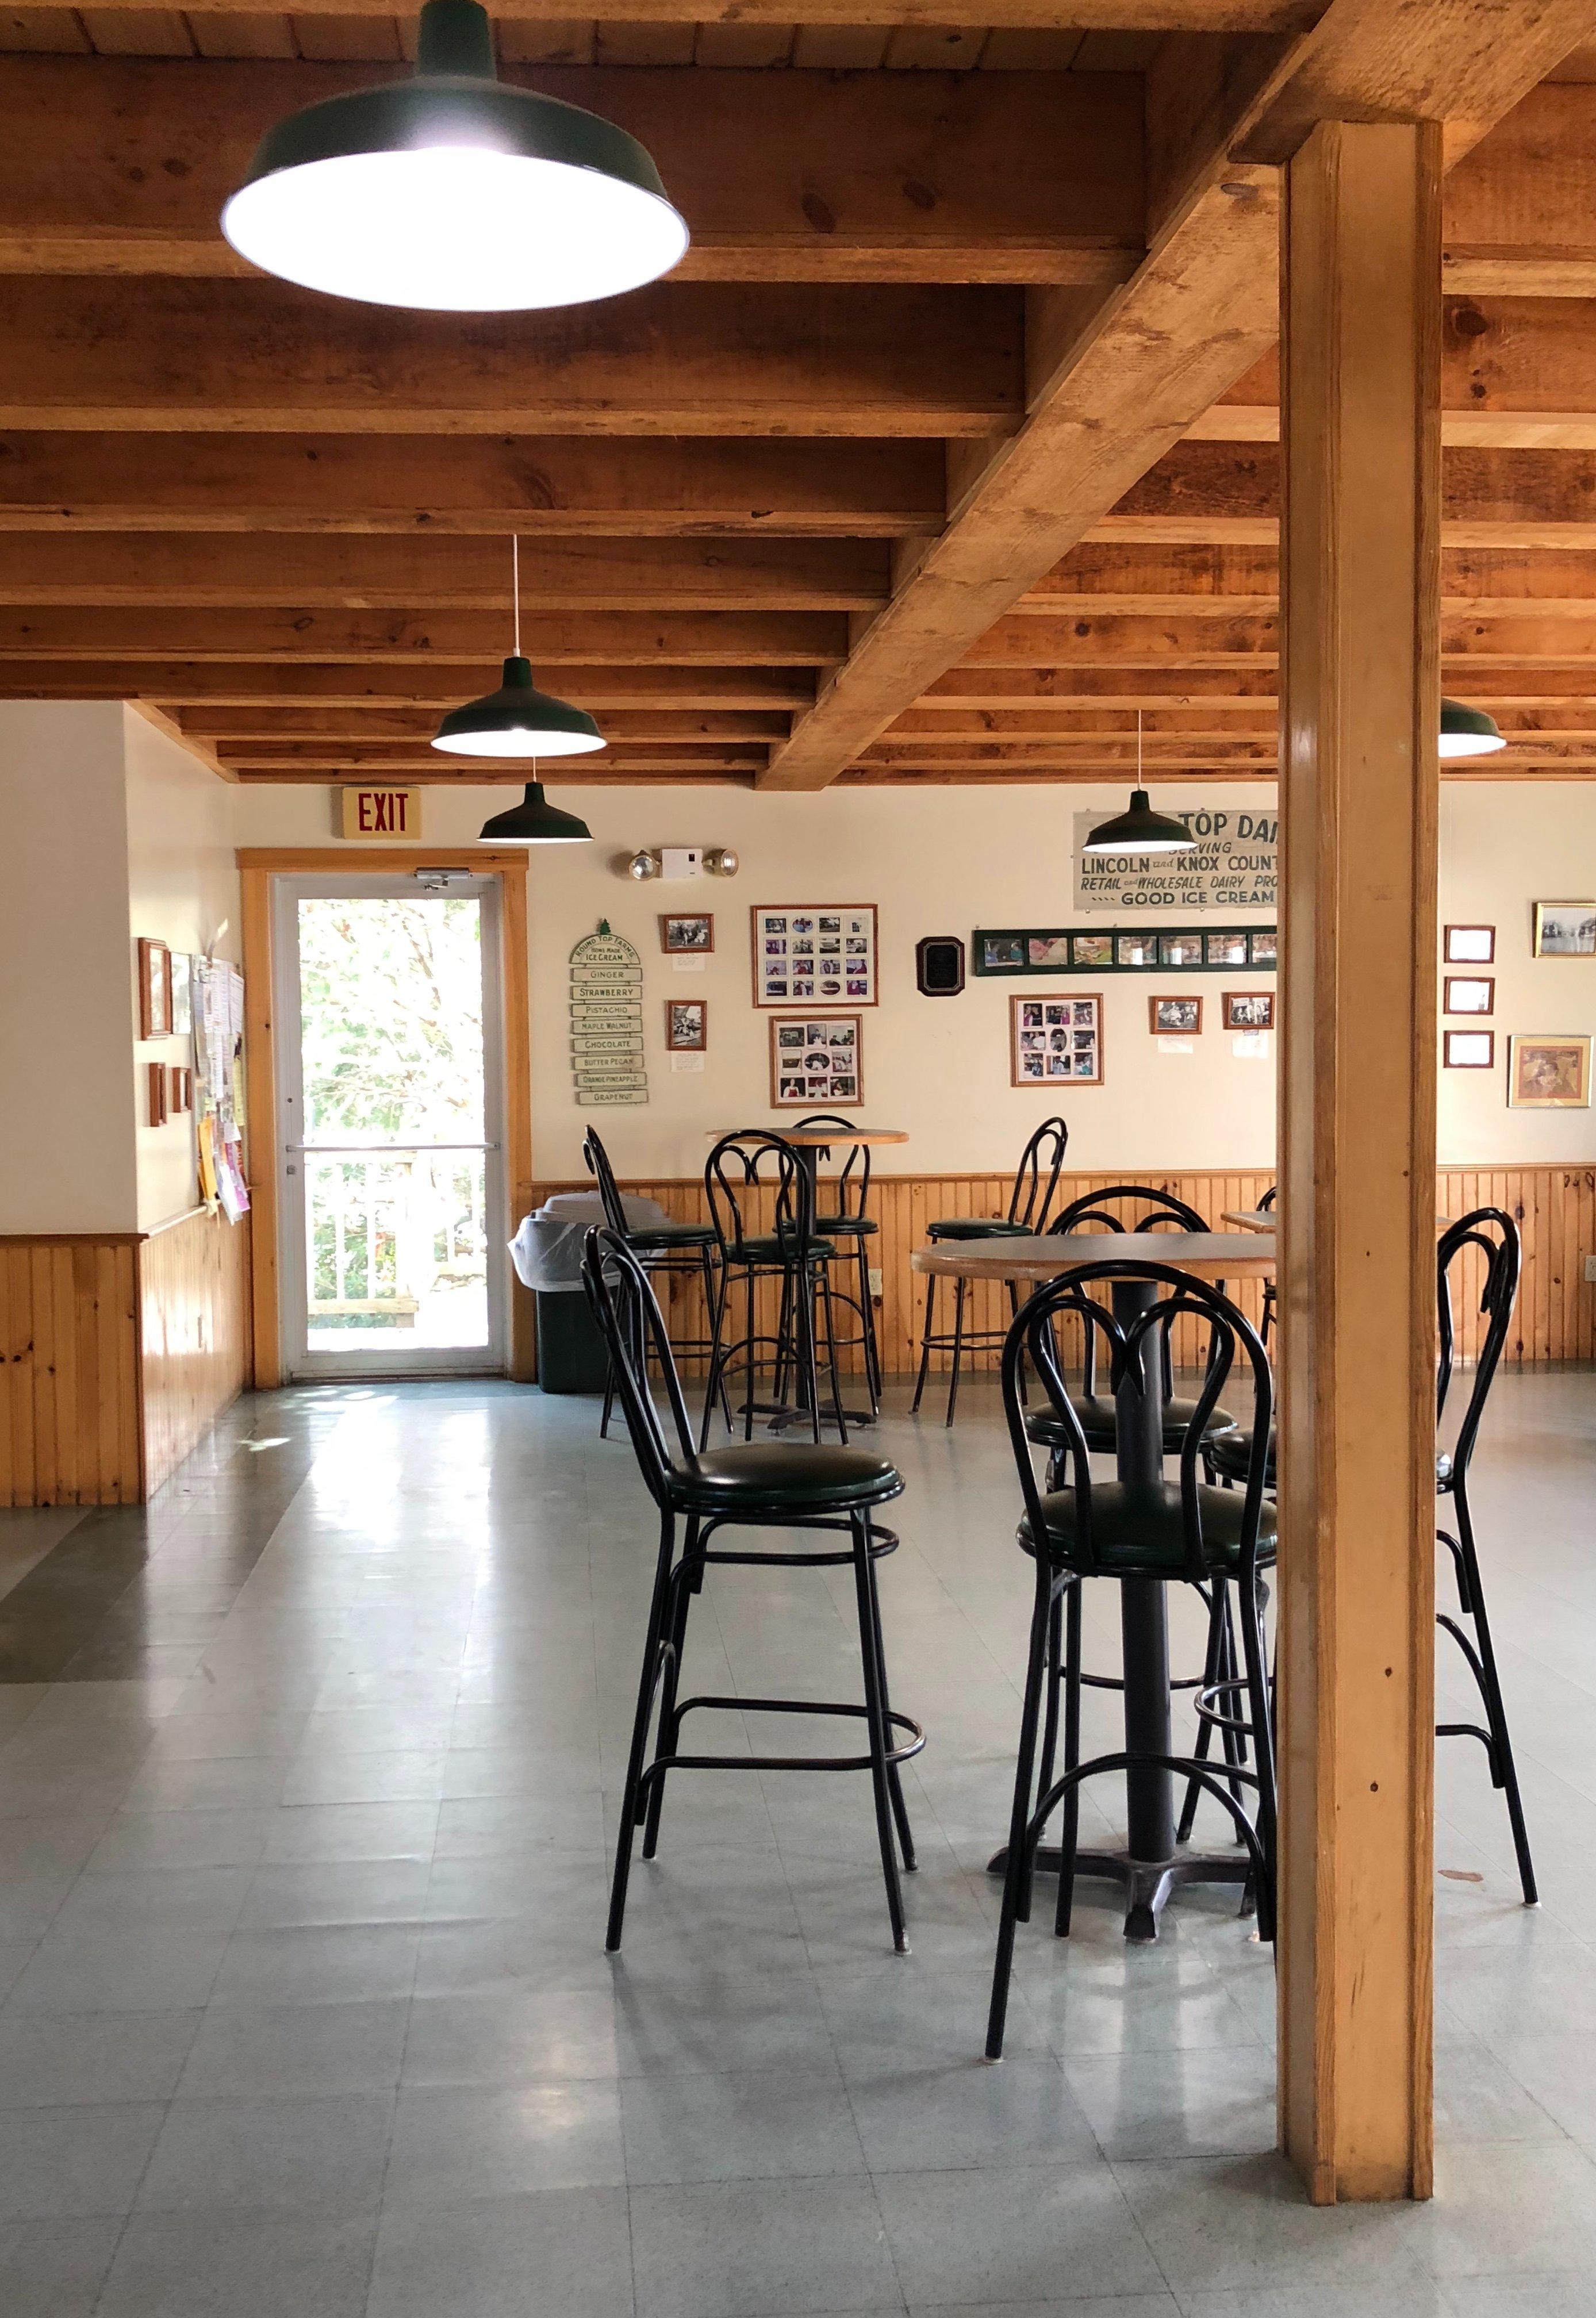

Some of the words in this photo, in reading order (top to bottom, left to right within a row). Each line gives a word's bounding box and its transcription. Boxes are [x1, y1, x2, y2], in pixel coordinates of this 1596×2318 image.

[358, 793, 409, 832] EXIT
[1178, 813, 1227, 836] TOP
[1237, 815, 1279, 843] DAI
[1081, 857, 1150, 874] LINCOLN
[1153, 858, 1174, 868] and
[1177, 856, 1219, 872] KNOX
[1081, 877, 1122, 891] RETAIL
[1137, 876, 1203, 889] WHOLESALE
[1210, 876, 1246, 888] DAIRY
[1121, 892, 1175, 905] GOOD
[1181, 891, 1207, 904] ICE
[1215, 891, 1275, 904] CREAM
[576, 938, 596, 957] ROUND
[614, 938, 635, 957] FARMS
[598, 953, 623, 961] CREAM
[590, 970, 624, 978] GINGER
[580, 988, 634, 996] STRAWBERRY
[585, 1040, 631, 1049] CHOCOLATE
[584, 1058, 609, 1066] BUTTER
[610, 1057, 633, 1065] PECAN
